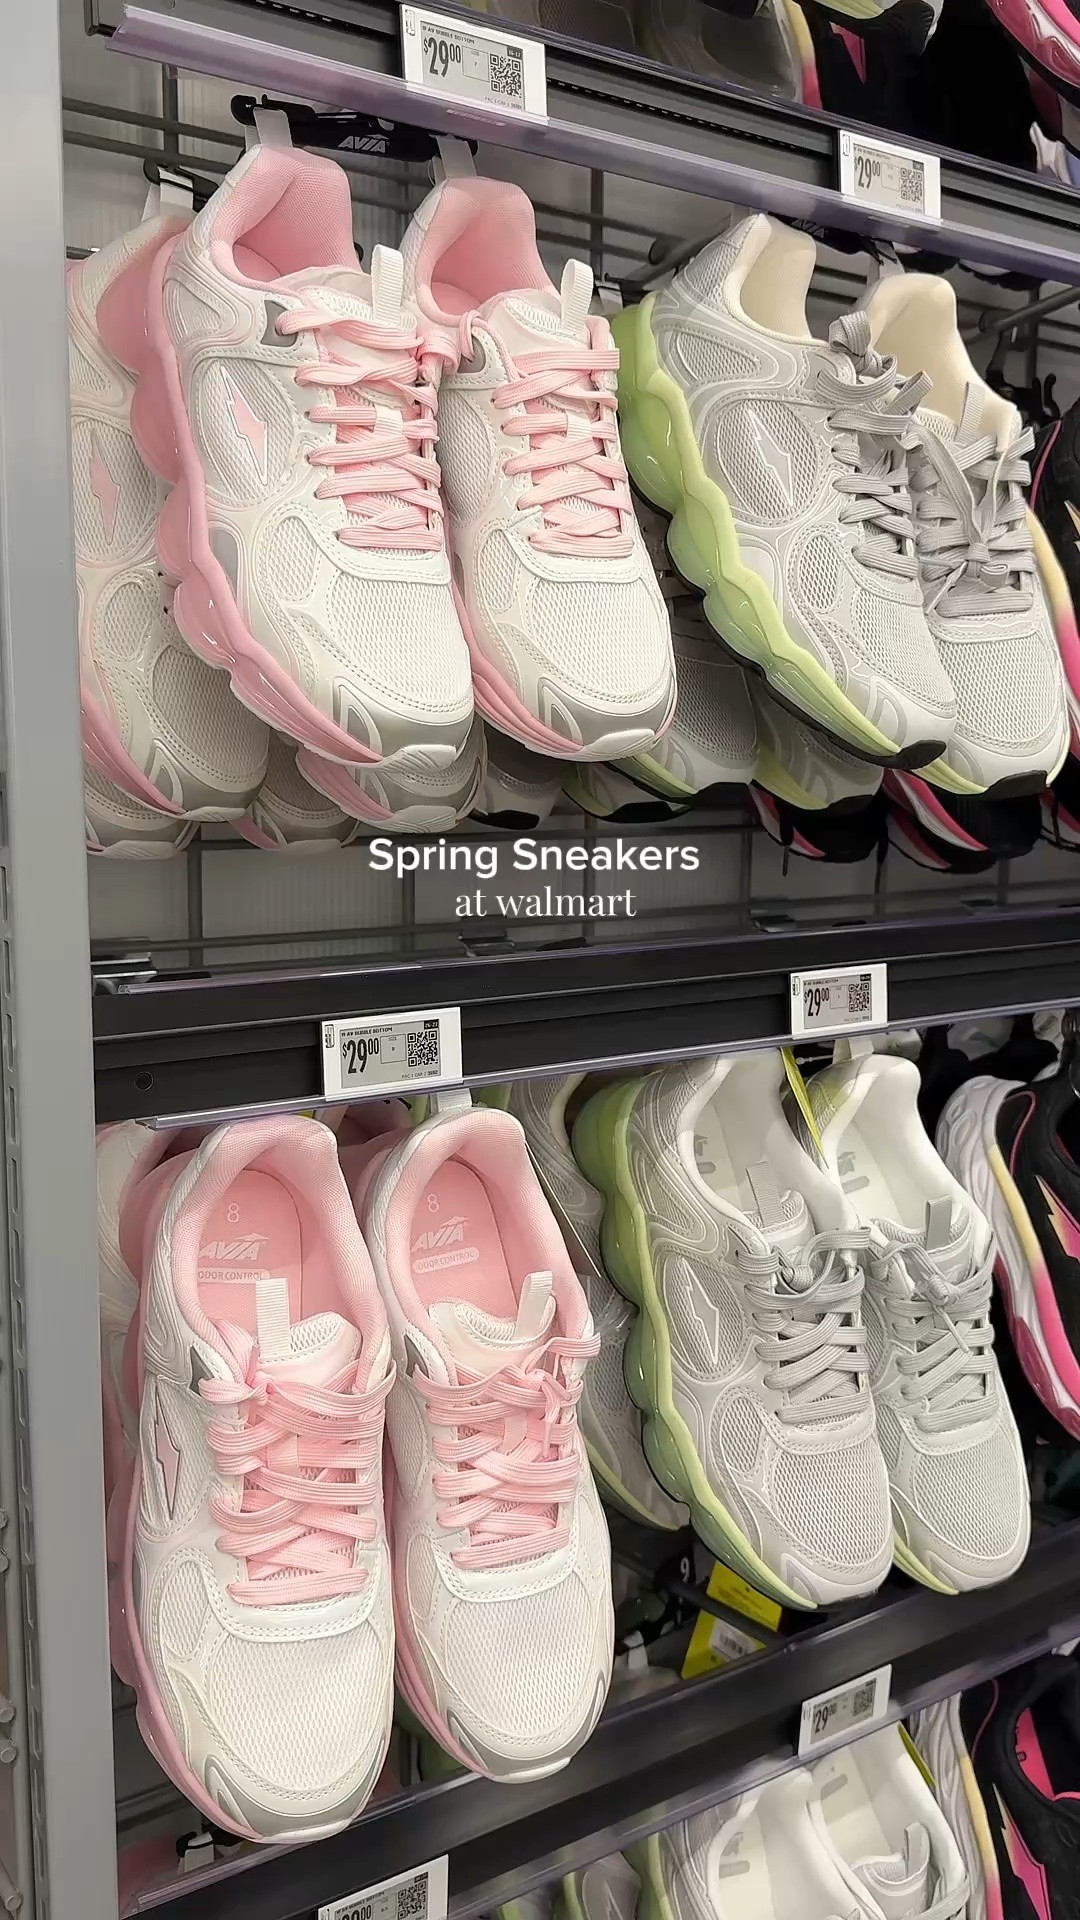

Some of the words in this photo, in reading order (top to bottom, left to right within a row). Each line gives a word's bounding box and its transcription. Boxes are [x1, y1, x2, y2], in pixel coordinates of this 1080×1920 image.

[338, 135, 386, 153] AVIA
[227, 1202, 239, 1223] 8
[427, 1193, 439, 1213] 8
[411, 1221, 465, 1252] AVIA
[200, 1239, 262, 1261] AVIA
[197, 1270, 223, 1279] ODOR
